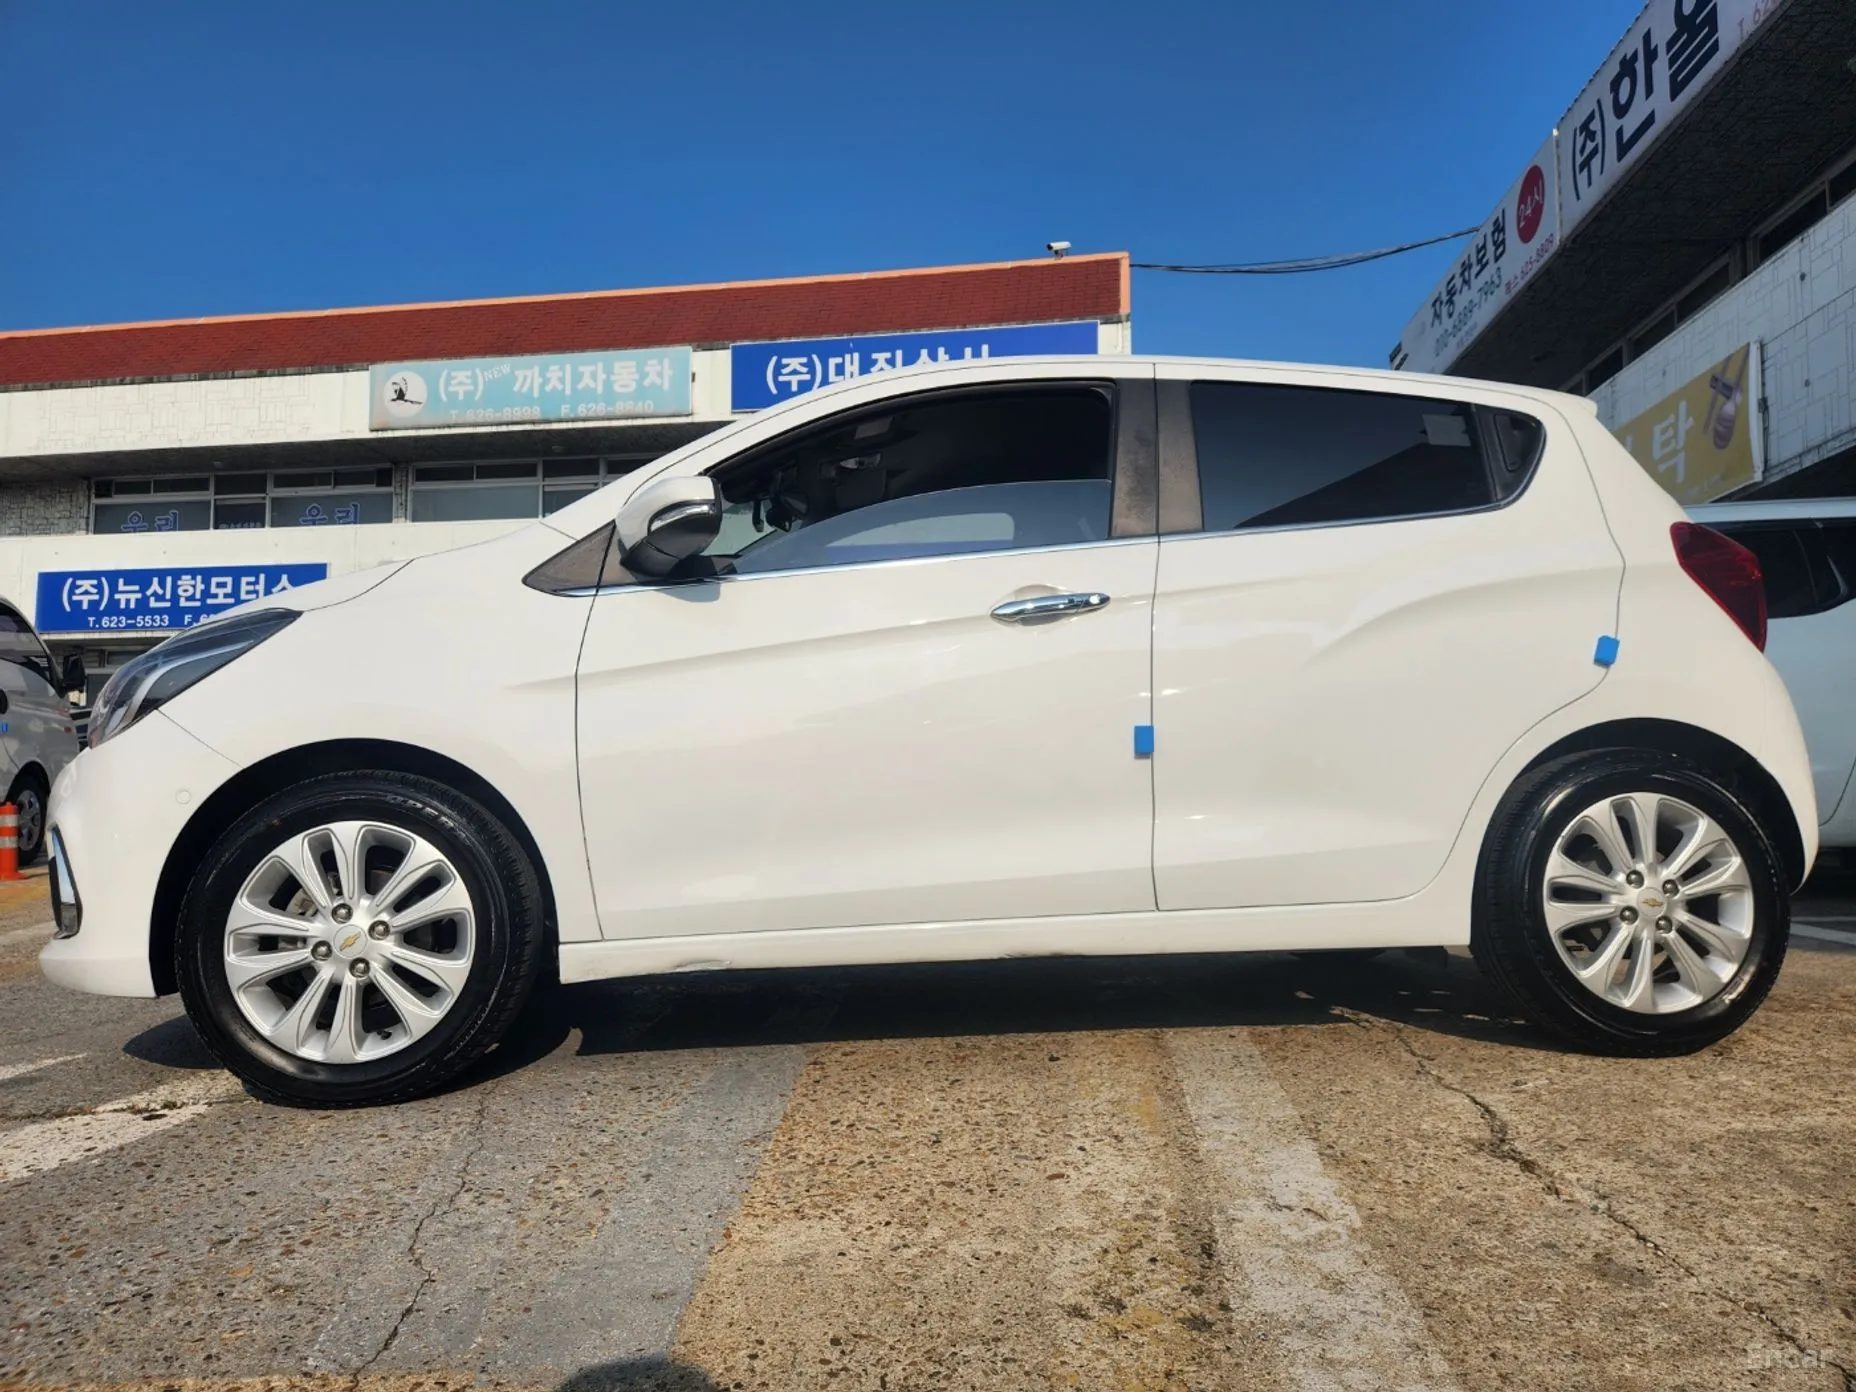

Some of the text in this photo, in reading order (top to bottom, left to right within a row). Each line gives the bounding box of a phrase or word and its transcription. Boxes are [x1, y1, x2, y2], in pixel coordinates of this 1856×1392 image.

[1430, 208, 1507, 329] 자동차보험
[483, 363, 511, 382] NEW
[512, 357, 674, 398] 까치자동차
[87, 614, 169, 628] T.623-5533
